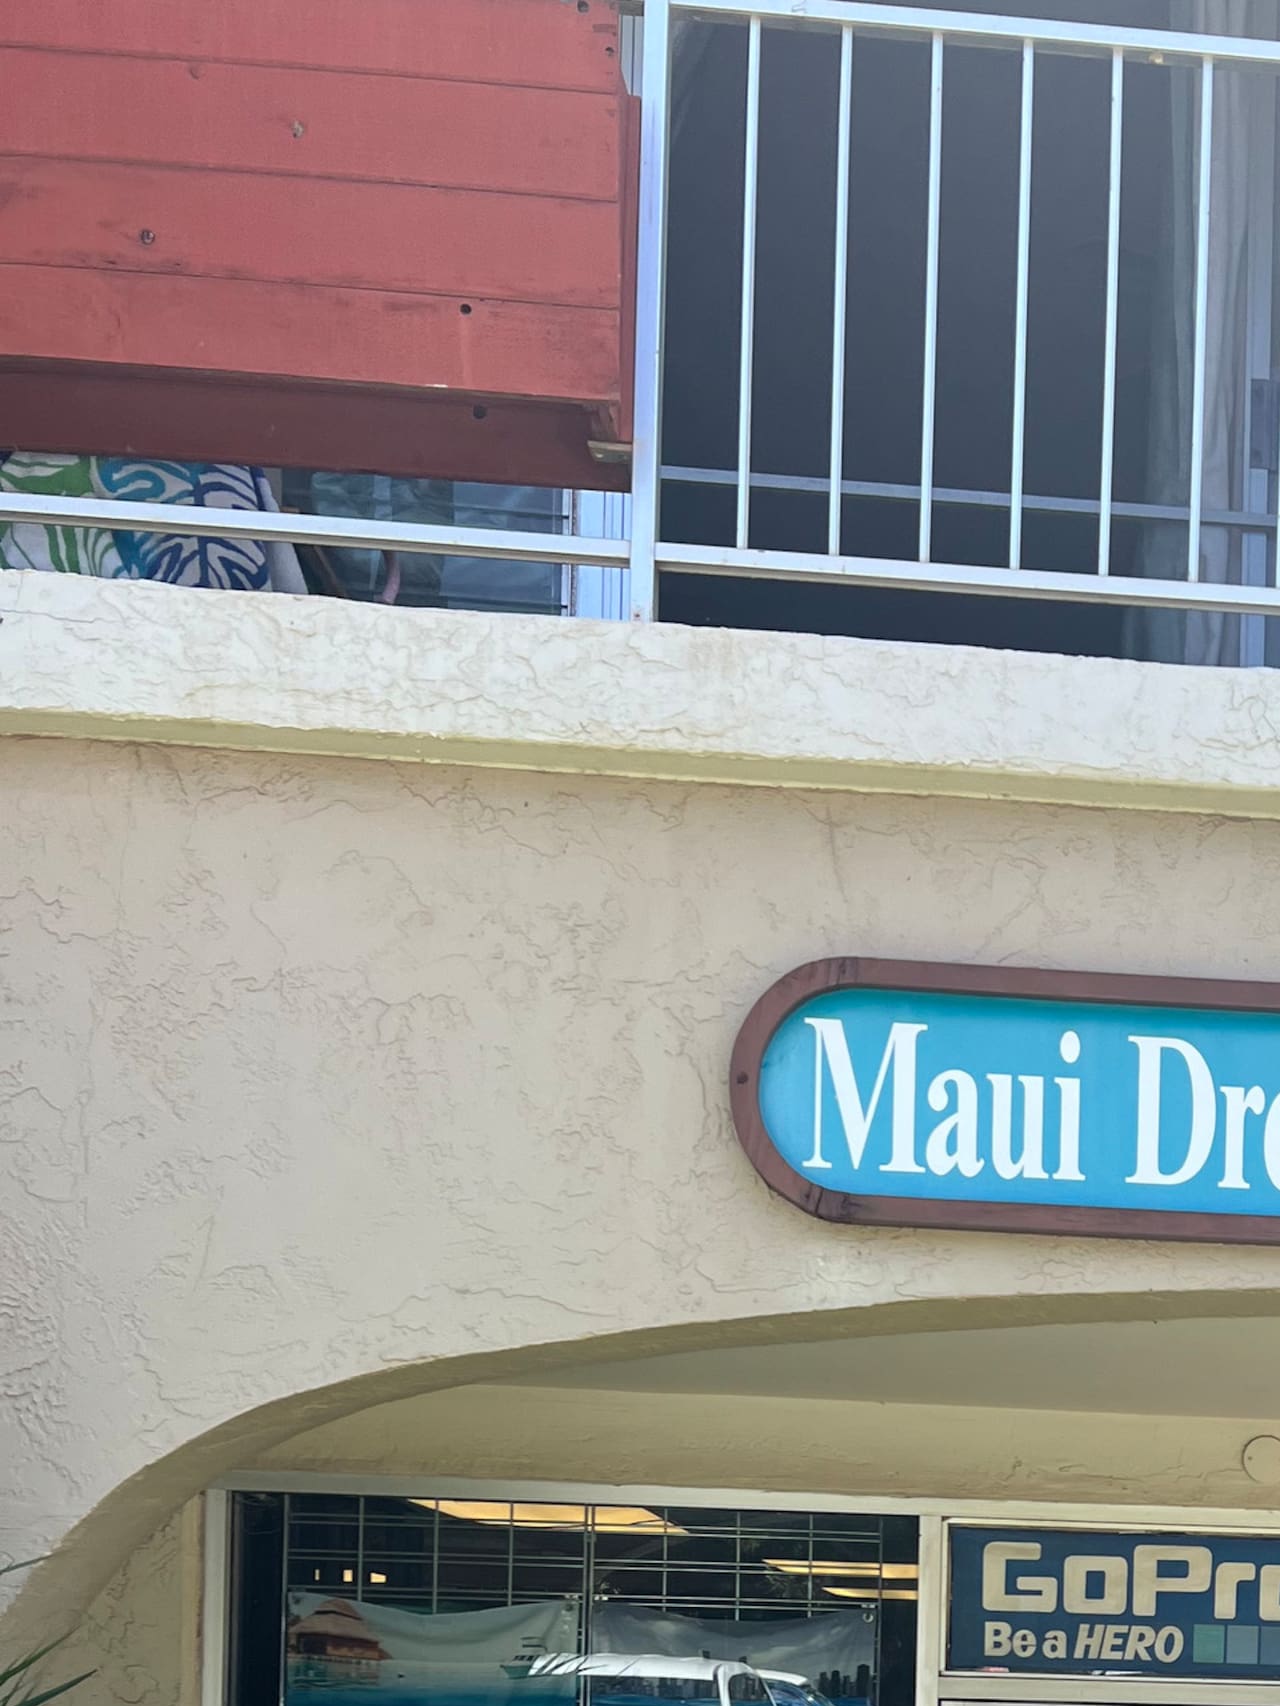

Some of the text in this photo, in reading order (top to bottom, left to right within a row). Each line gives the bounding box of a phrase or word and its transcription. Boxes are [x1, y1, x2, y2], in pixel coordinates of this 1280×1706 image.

[802, 1016, 1082, 1181] Maui
[984, 1621, 1185, 1663] Be a HERO
